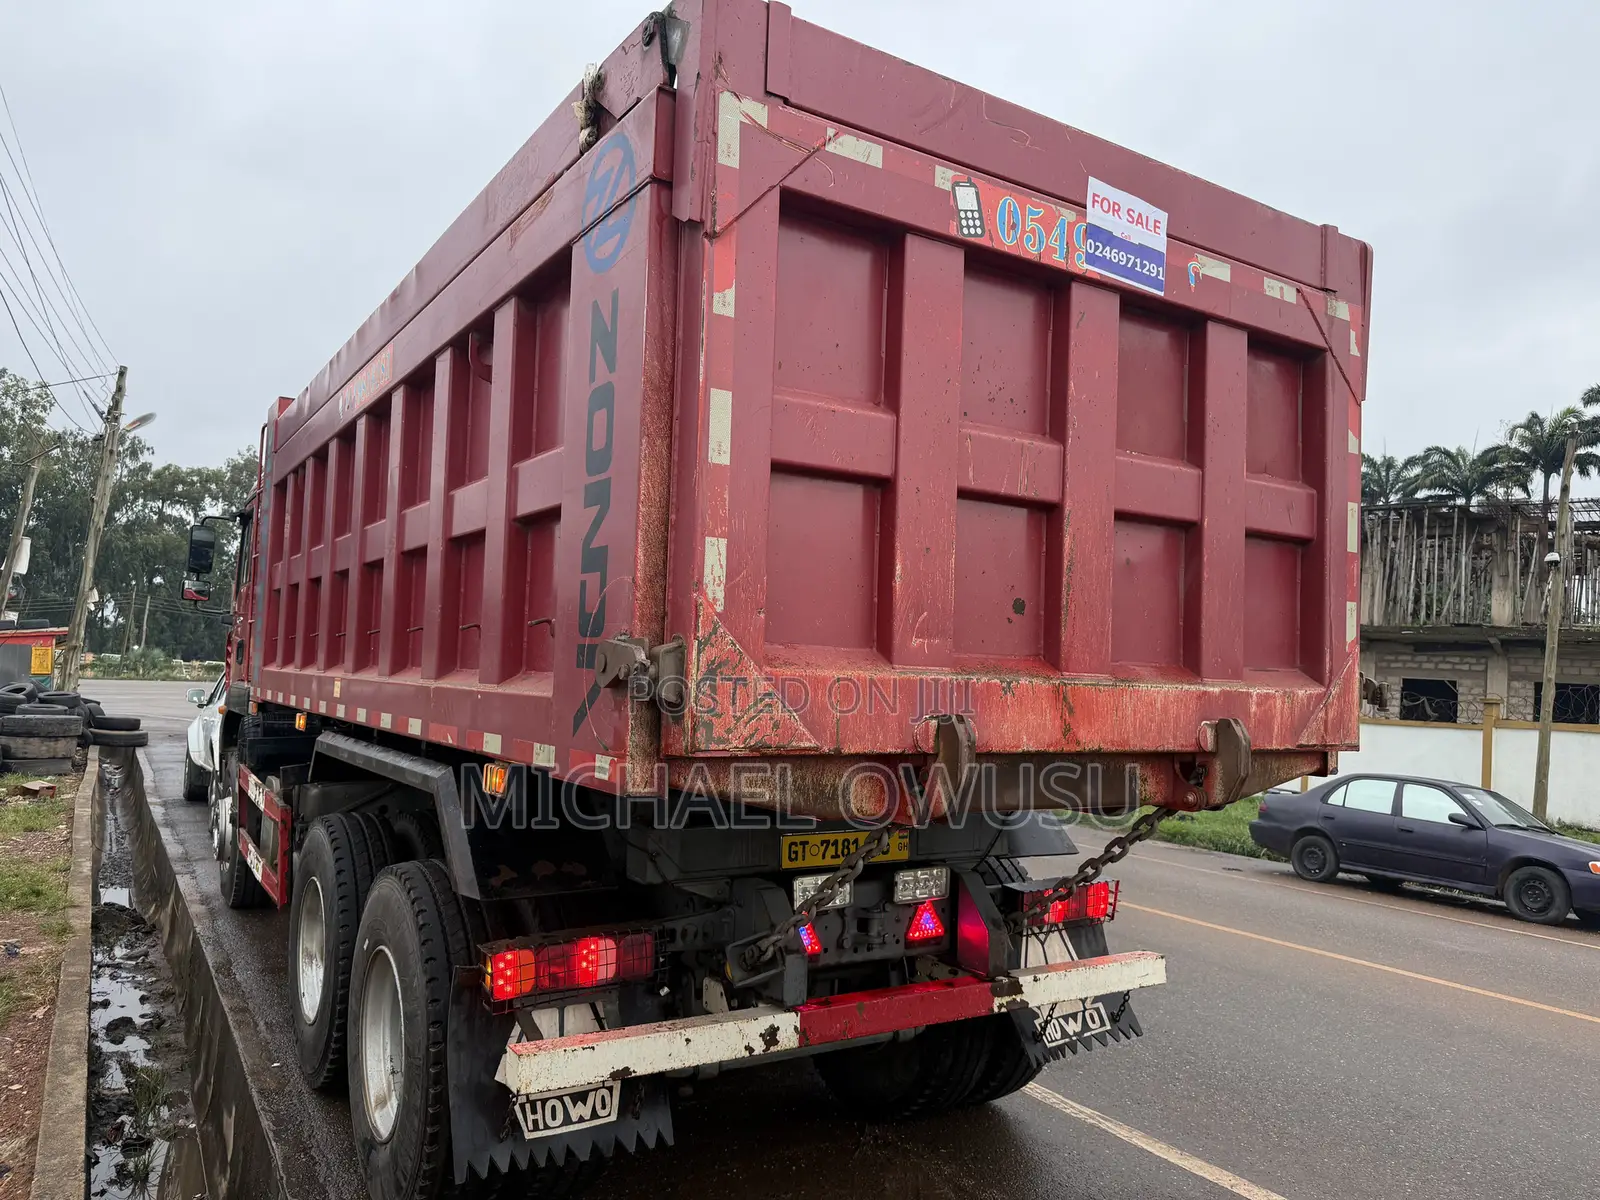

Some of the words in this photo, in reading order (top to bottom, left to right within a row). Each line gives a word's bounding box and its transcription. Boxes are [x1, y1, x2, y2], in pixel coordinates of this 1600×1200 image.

[1092, 192, 1122, 220] FOR
[1126, 207, 1162, 236] SALE
[1086, 239, 1165, 280] 0246971291
[897, 842, 908, 852] GH
[524, 1087, 612, 1131] HOWO
